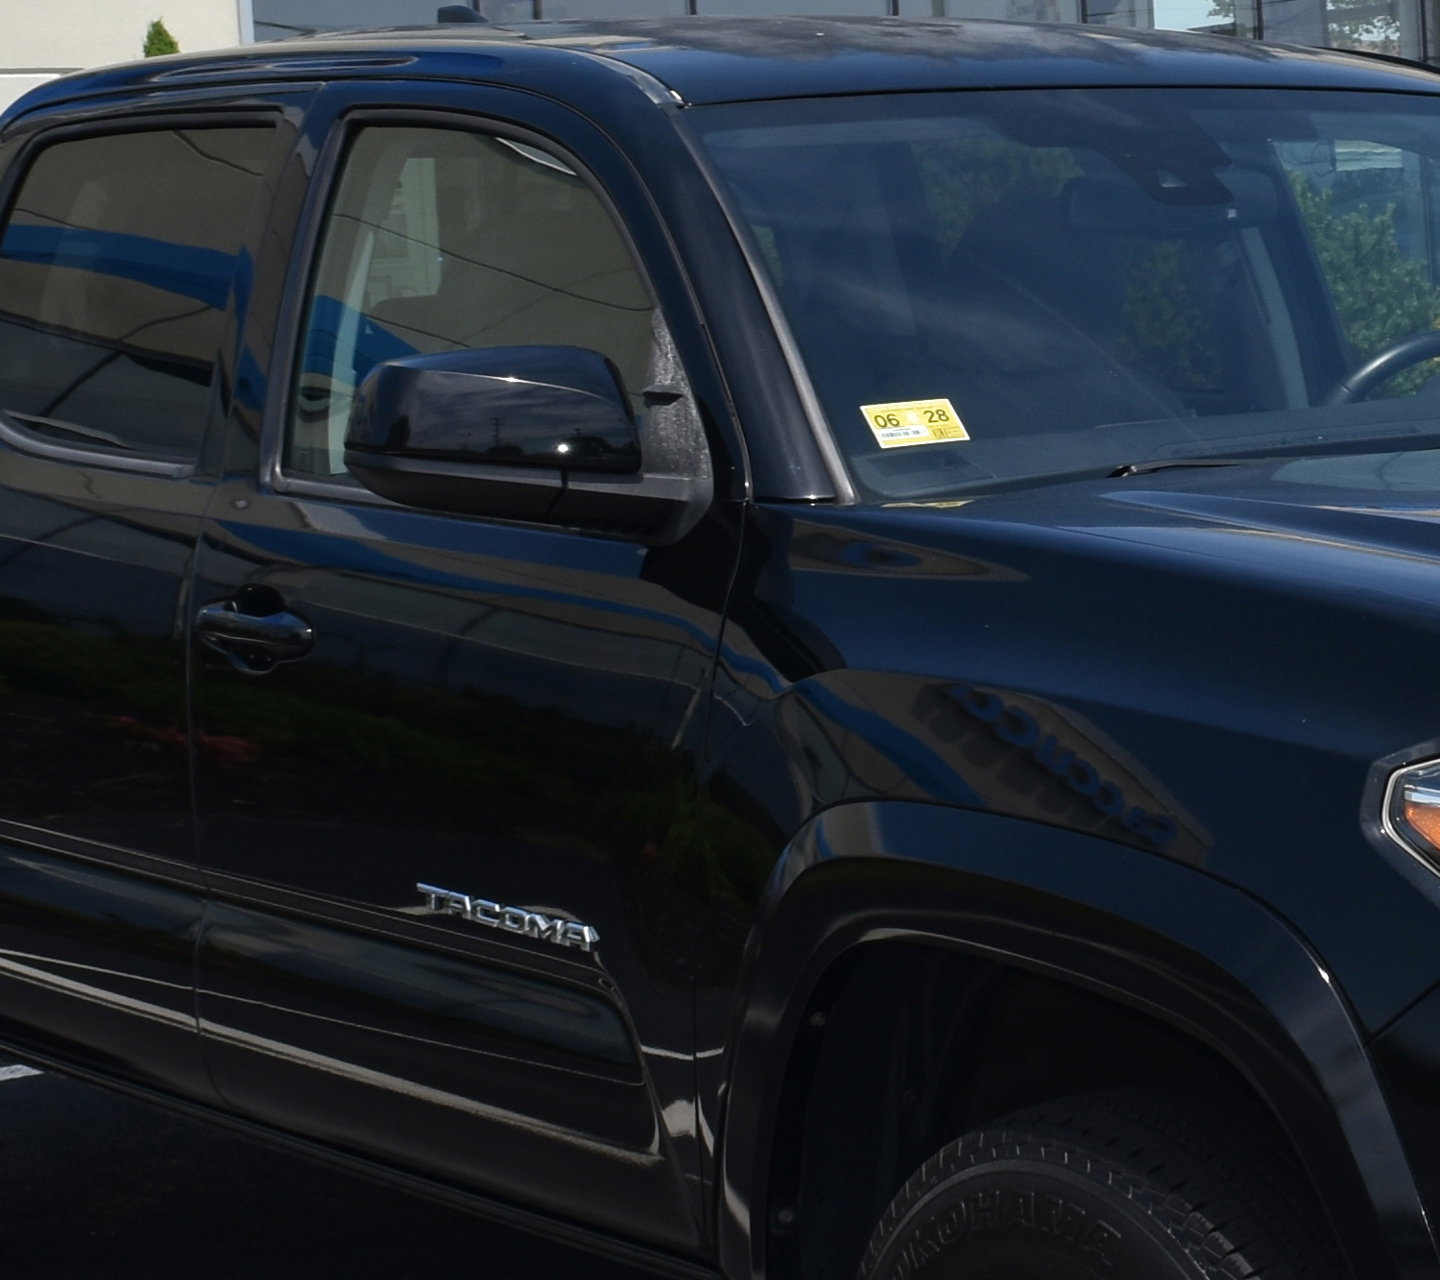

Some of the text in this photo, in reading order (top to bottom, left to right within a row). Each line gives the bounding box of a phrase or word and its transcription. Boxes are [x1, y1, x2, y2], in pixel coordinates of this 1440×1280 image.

[873, 409, 950, 428] 06 28
[415, 882, 600, 952] TACOMA
